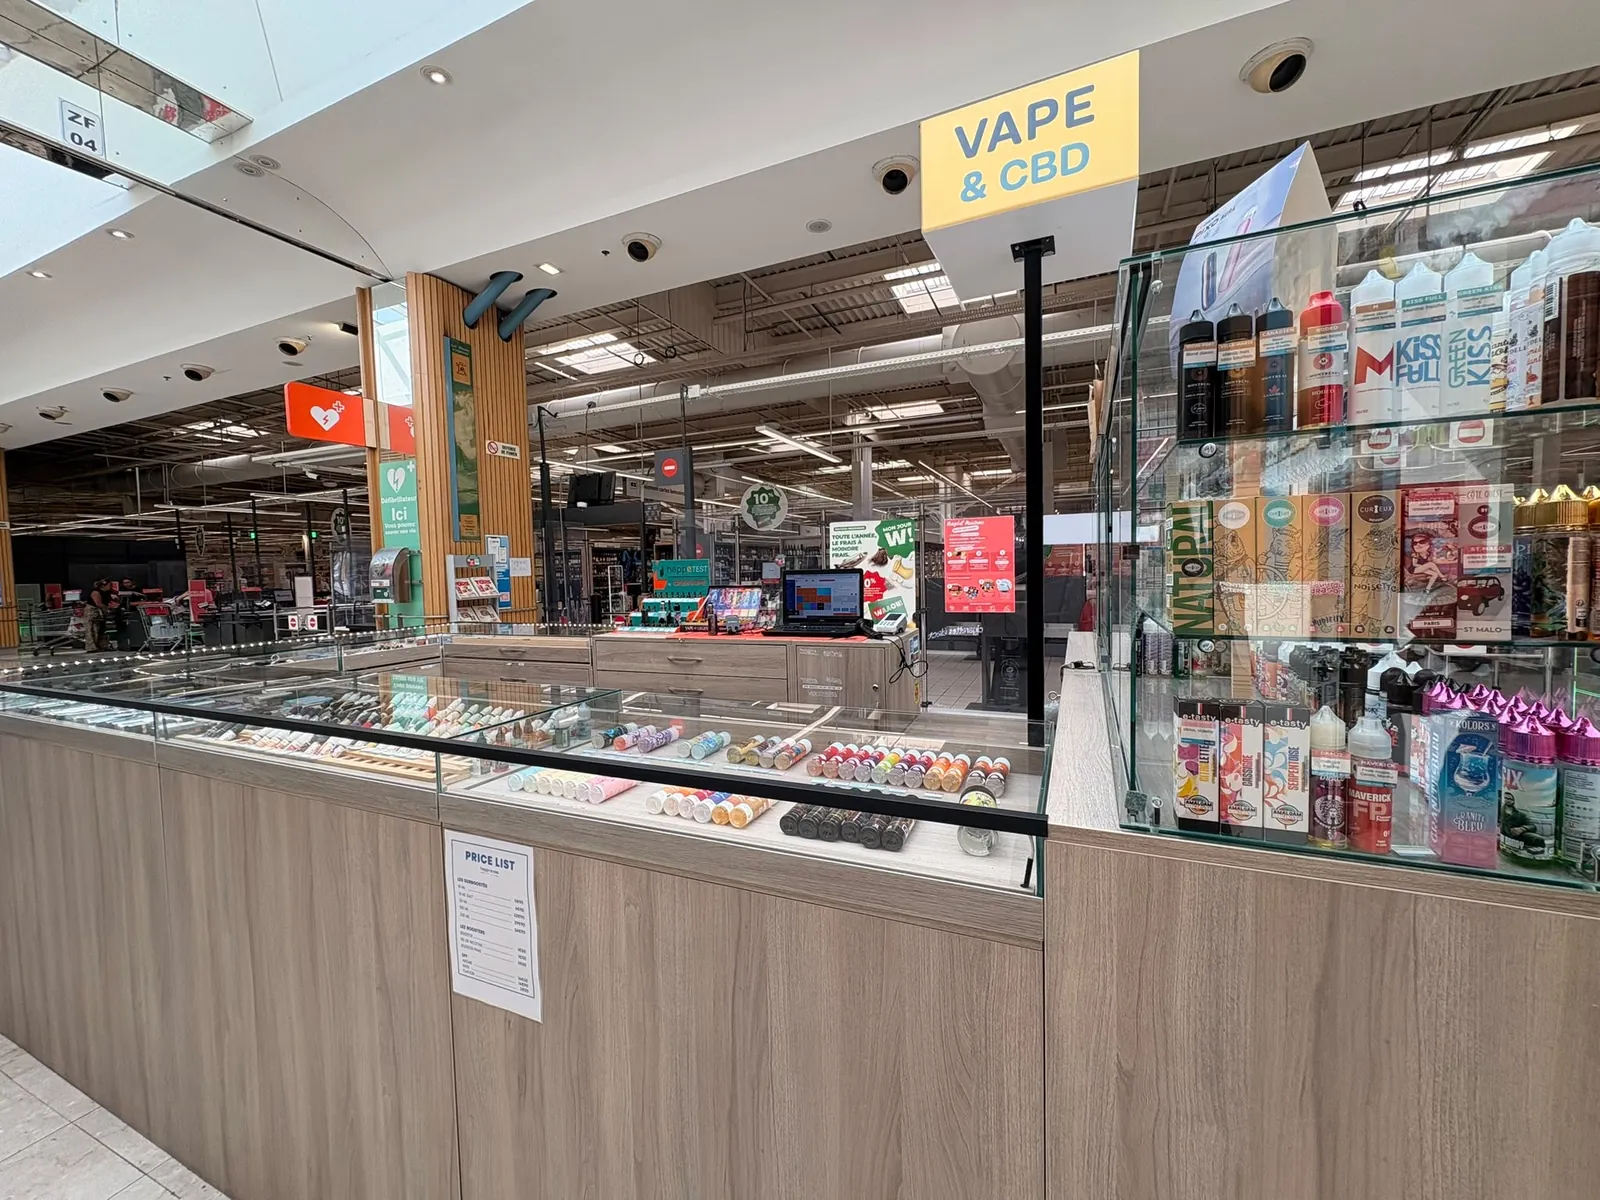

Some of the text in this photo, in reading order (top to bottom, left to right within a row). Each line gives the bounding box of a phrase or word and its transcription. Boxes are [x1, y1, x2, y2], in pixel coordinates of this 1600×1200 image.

[68, 109, 96, 128] ZF
[954, 84, 1095, 159] VAPE
[70, 132, 97, 152] 04
[960, 142, 1090, 202] & CBD
[1406, 297, 1423, 305] KISS
[1354, 344, 1394, 385] M
[1449, 328, 1467, 388] GREEN
[1467, 326, 1491, 386] KISS
[1396, 360, 1440, 387] FULL
[754, 492, 774, 504] 10%
[392, 507, 407, 521] Ici
[1360, 505, 1393, 514] CURIEUX
[884, 528, 914, 547] W!
[1173, 500, 1213, 634] NATURAL
[864, 577, 876, 587] 0%
[1455, 720, 1490, 731] KOLORS
[1361, 760, 1395, 768] MAVERICK
[1186, 799, 1212, 807] AMALGAM
[1349, 789, 1391, 802] MAVERICK
[1354, 801, 1387, 820] FP
[1453, 818, 1483, 832] BLEU
[465, 851, 515, 870] PRICE LIST
